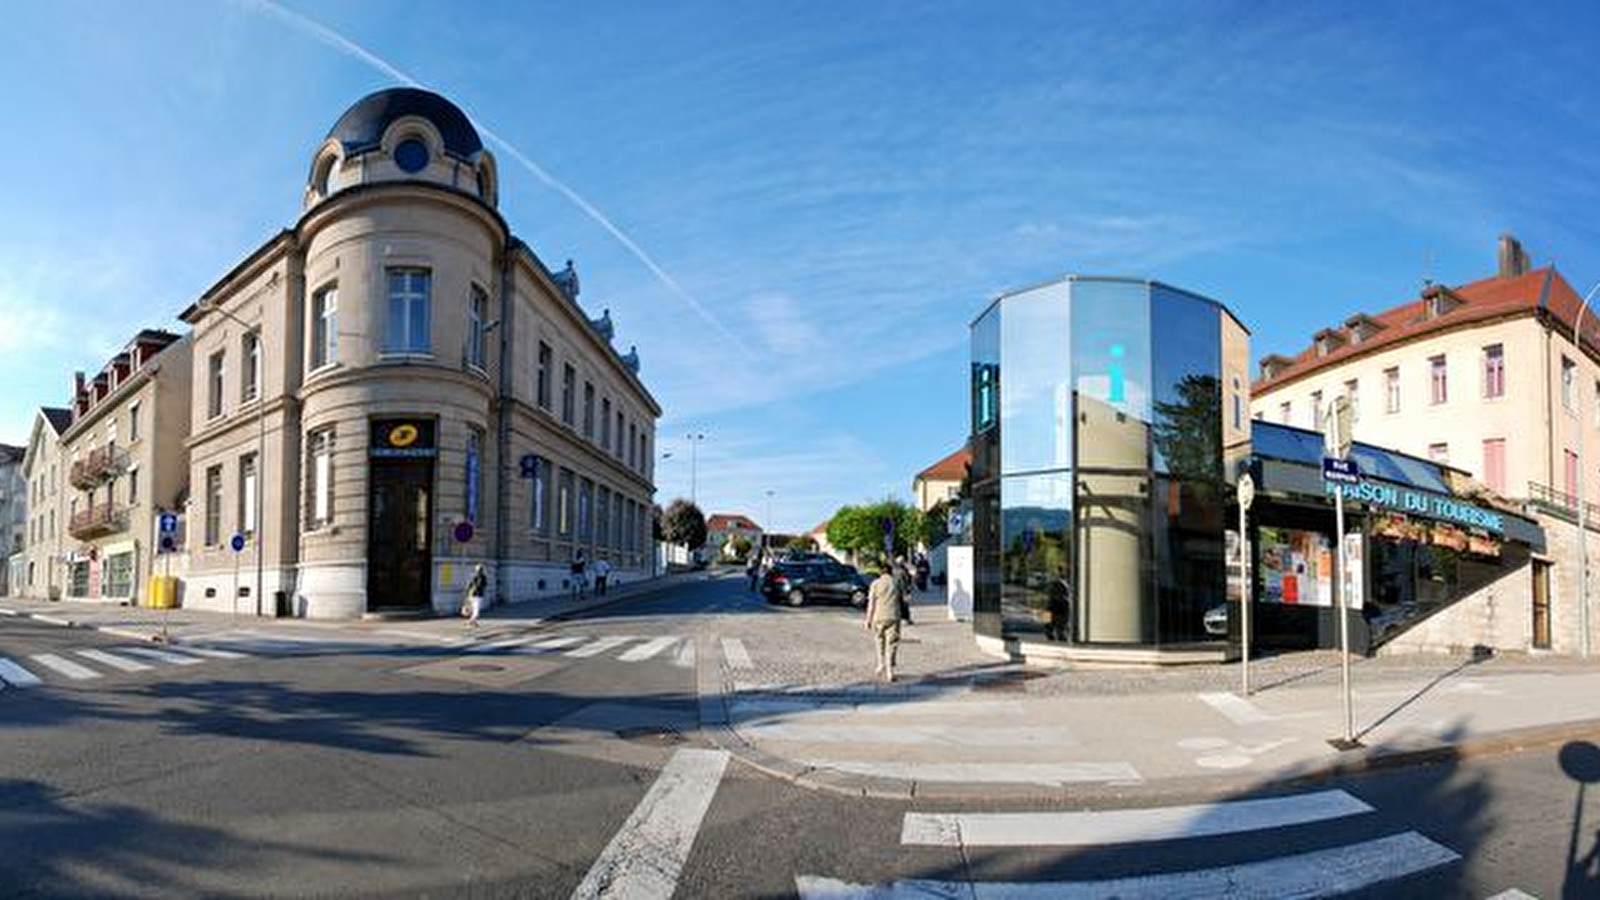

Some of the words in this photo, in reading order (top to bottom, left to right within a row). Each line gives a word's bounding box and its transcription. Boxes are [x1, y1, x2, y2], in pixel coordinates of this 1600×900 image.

[981, 369, 990, 425] i
[1109, 344, 1126, 403] i
[1405, 492, 1428, 512] DU
[1432, 497, 1504, 531] TOURISME
